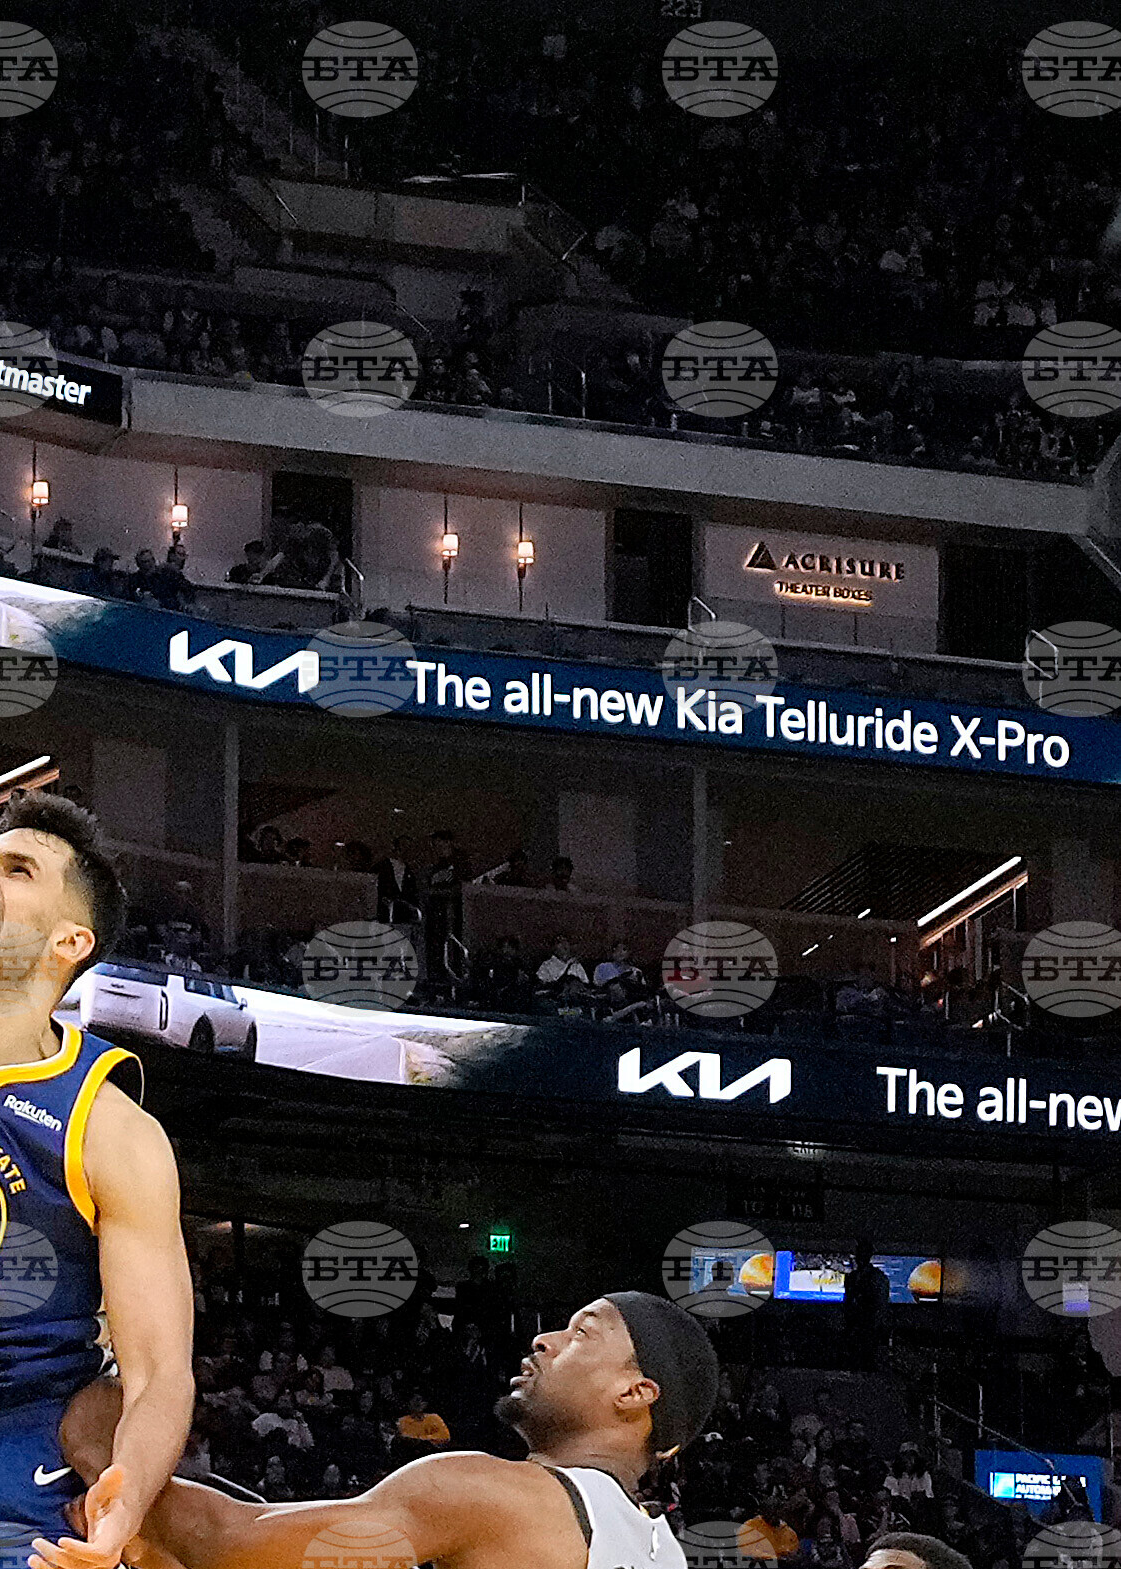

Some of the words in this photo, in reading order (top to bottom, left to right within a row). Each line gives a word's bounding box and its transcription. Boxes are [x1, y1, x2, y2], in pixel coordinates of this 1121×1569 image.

[783, 552, 905, 581] ACRISURE
[776, 580, 830, 597] THEATER
[406, 660, 491, 710] The
[504, 672, 663, 726] all-new
[676, 686, 743, 735] Kia
[756, 695, 939, 754] Telluride
[950, 715, 1070, 768] X-Pro
[876, 1066, 964, 1119] The
[3, 1095, 63, 1132] Rakuten
